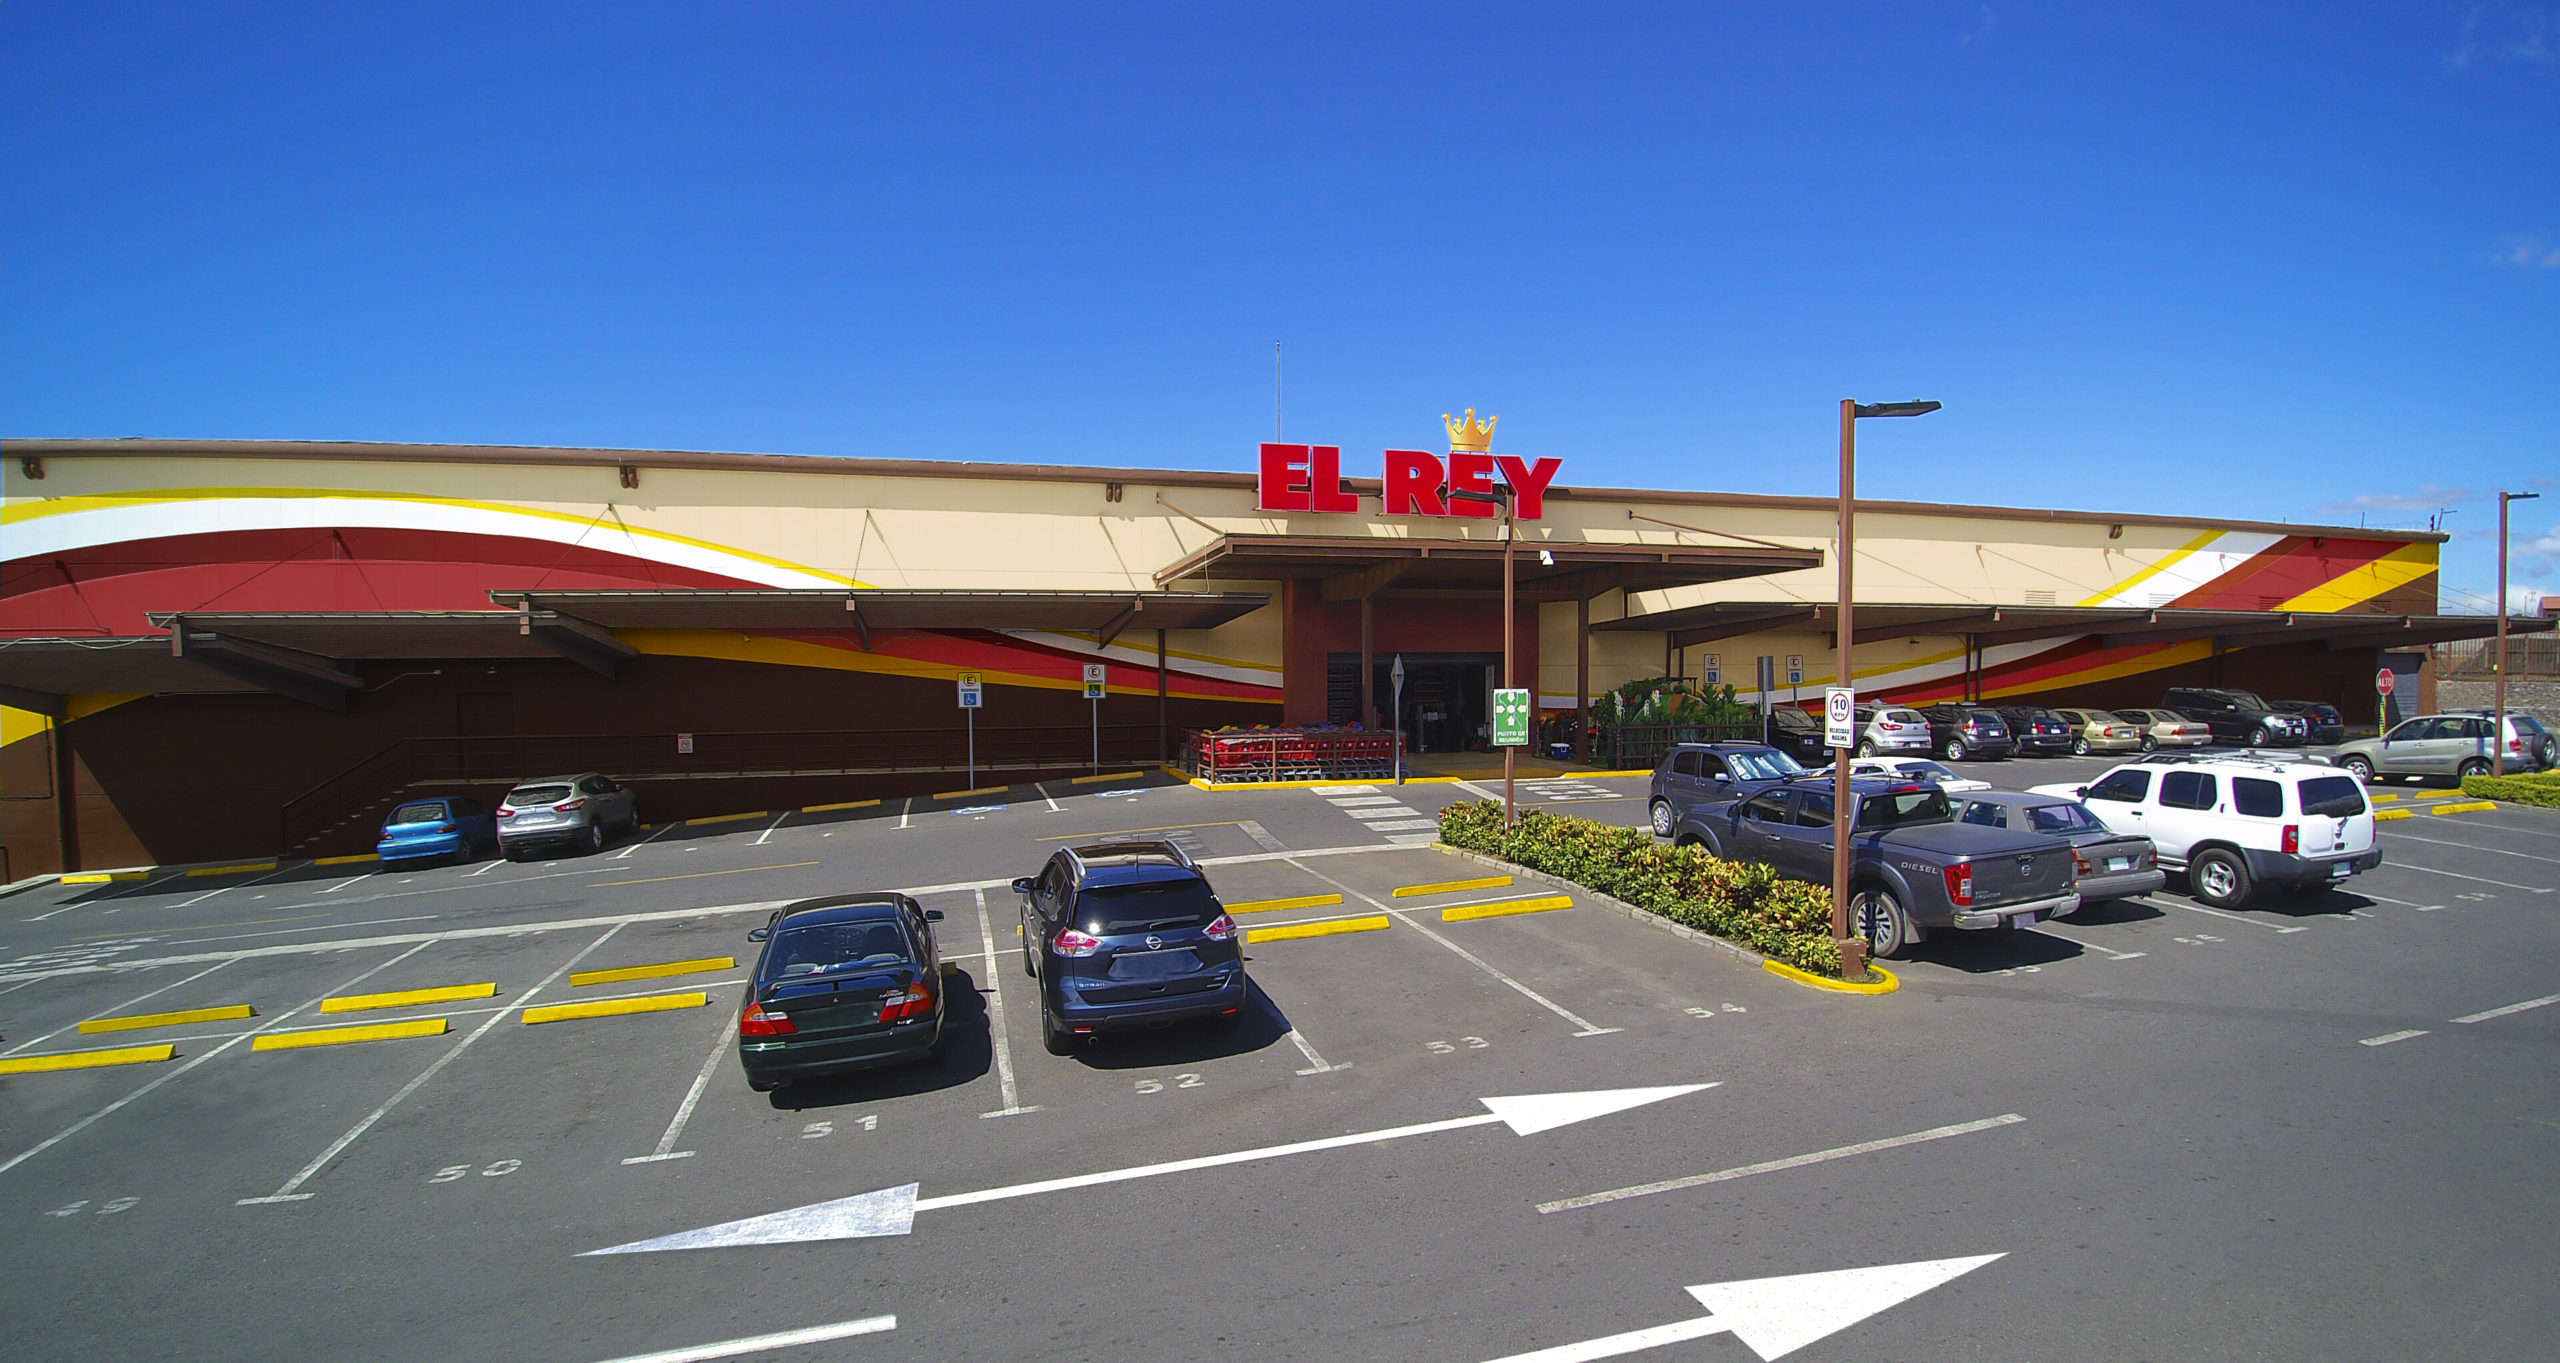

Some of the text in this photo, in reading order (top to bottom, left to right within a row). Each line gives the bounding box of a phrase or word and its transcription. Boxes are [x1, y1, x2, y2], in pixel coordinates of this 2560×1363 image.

[1258, 442, 1563, 520] EL REY
[2378, 677, 2392, 687] ALTO
[1834, 699, 1846, 710] 10
[1900, 861, 1939, 875] DIESEL
[1683, 1002, 1747, 1018] 54
[1425, 1036, 1490, 1054] 53
[1134, 1073, 1206, 1095] 52
[801, 1114, 879, 1139] 51
[428, 1158, 523, 1184] 50
